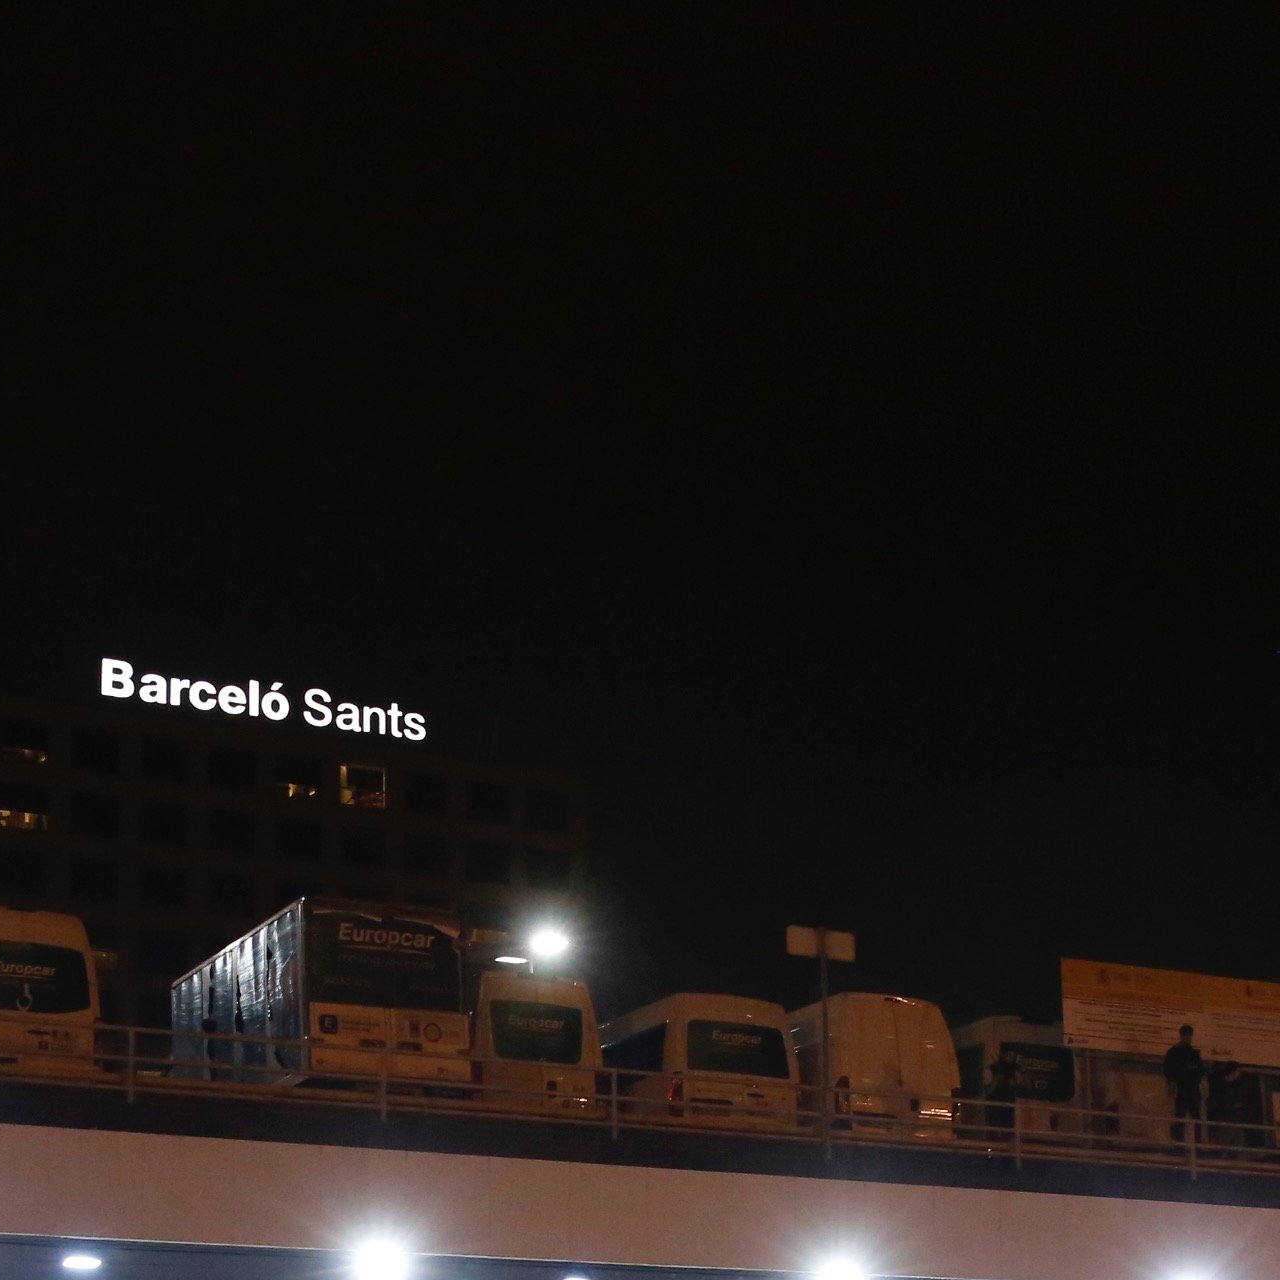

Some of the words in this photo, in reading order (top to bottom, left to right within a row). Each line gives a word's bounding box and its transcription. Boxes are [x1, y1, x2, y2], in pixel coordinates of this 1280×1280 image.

[101, 658, 289, 720] Barceló
[304, 689, 426, 740] Sants
[339, 923, 435, 949] Europcar
